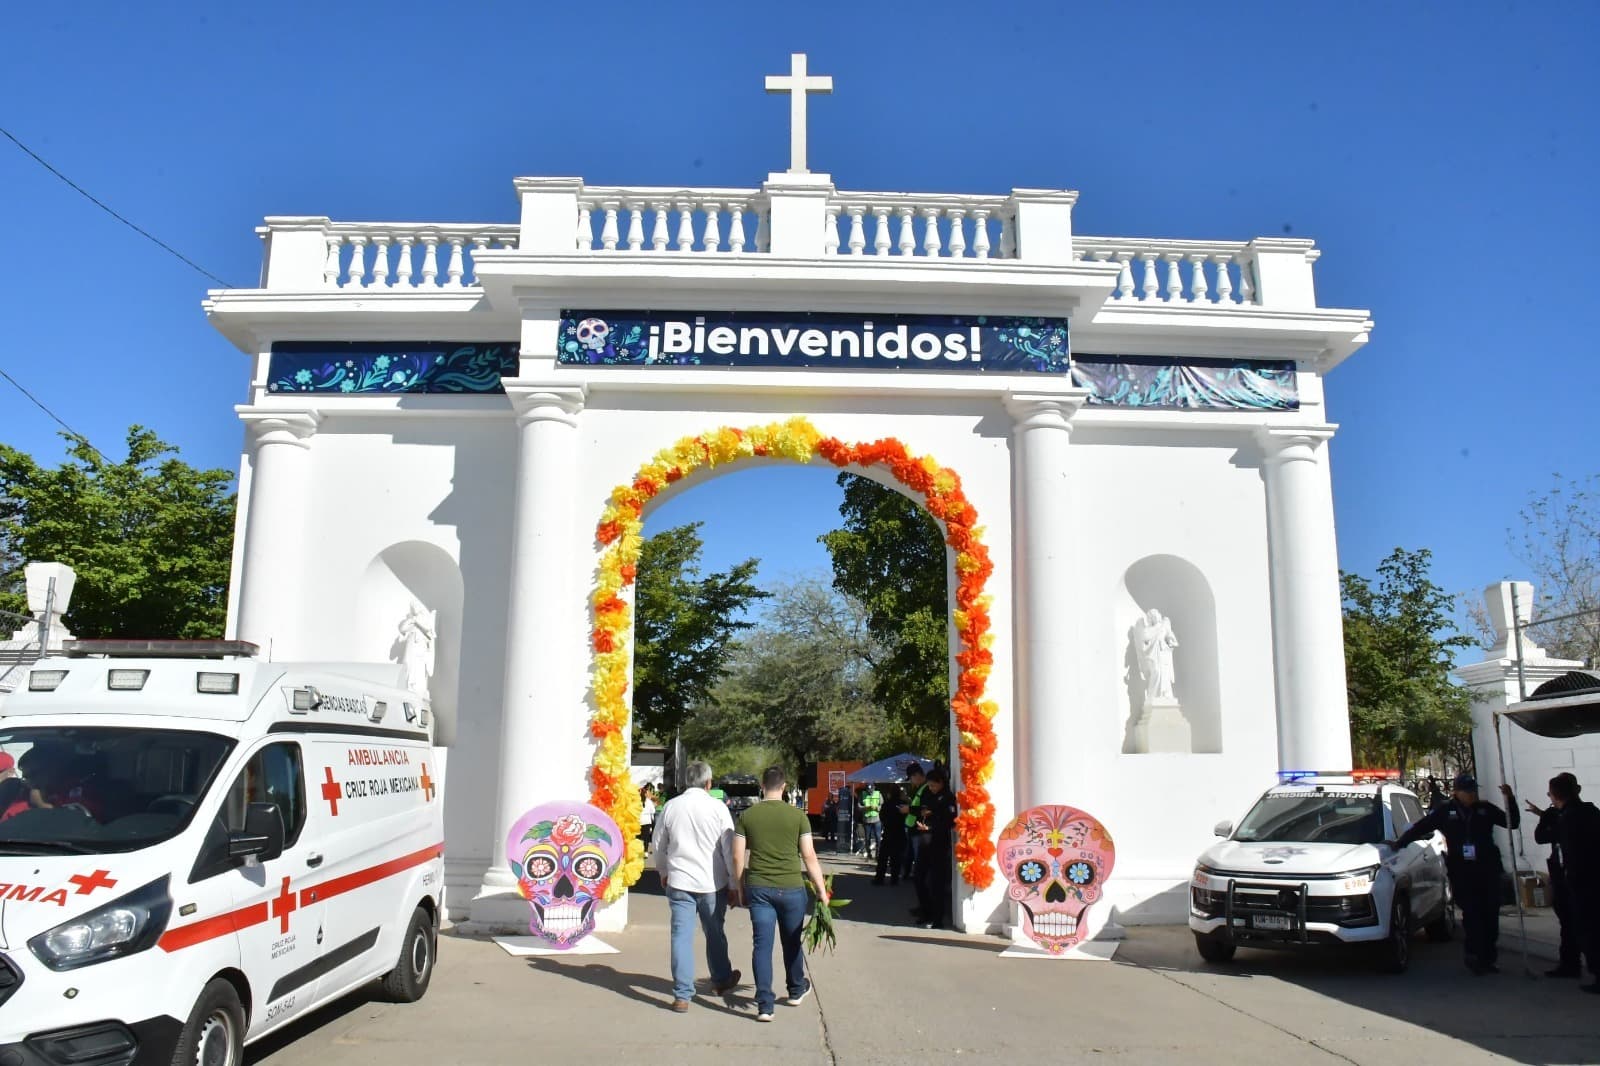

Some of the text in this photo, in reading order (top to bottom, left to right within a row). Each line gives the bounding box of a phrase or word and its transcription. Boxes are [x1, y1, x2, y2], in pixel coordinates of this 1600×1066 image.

[649, 316, 982, 362] ¡Bienvenidos!
[348, 749, 409, 766] AMBULANCIA
[345, 776, 419, 799] CRUZ ROJA MEXICANA
[271, 939, 284, 951] CRUZ
[271, 944, 296, 960] MEXICANA
